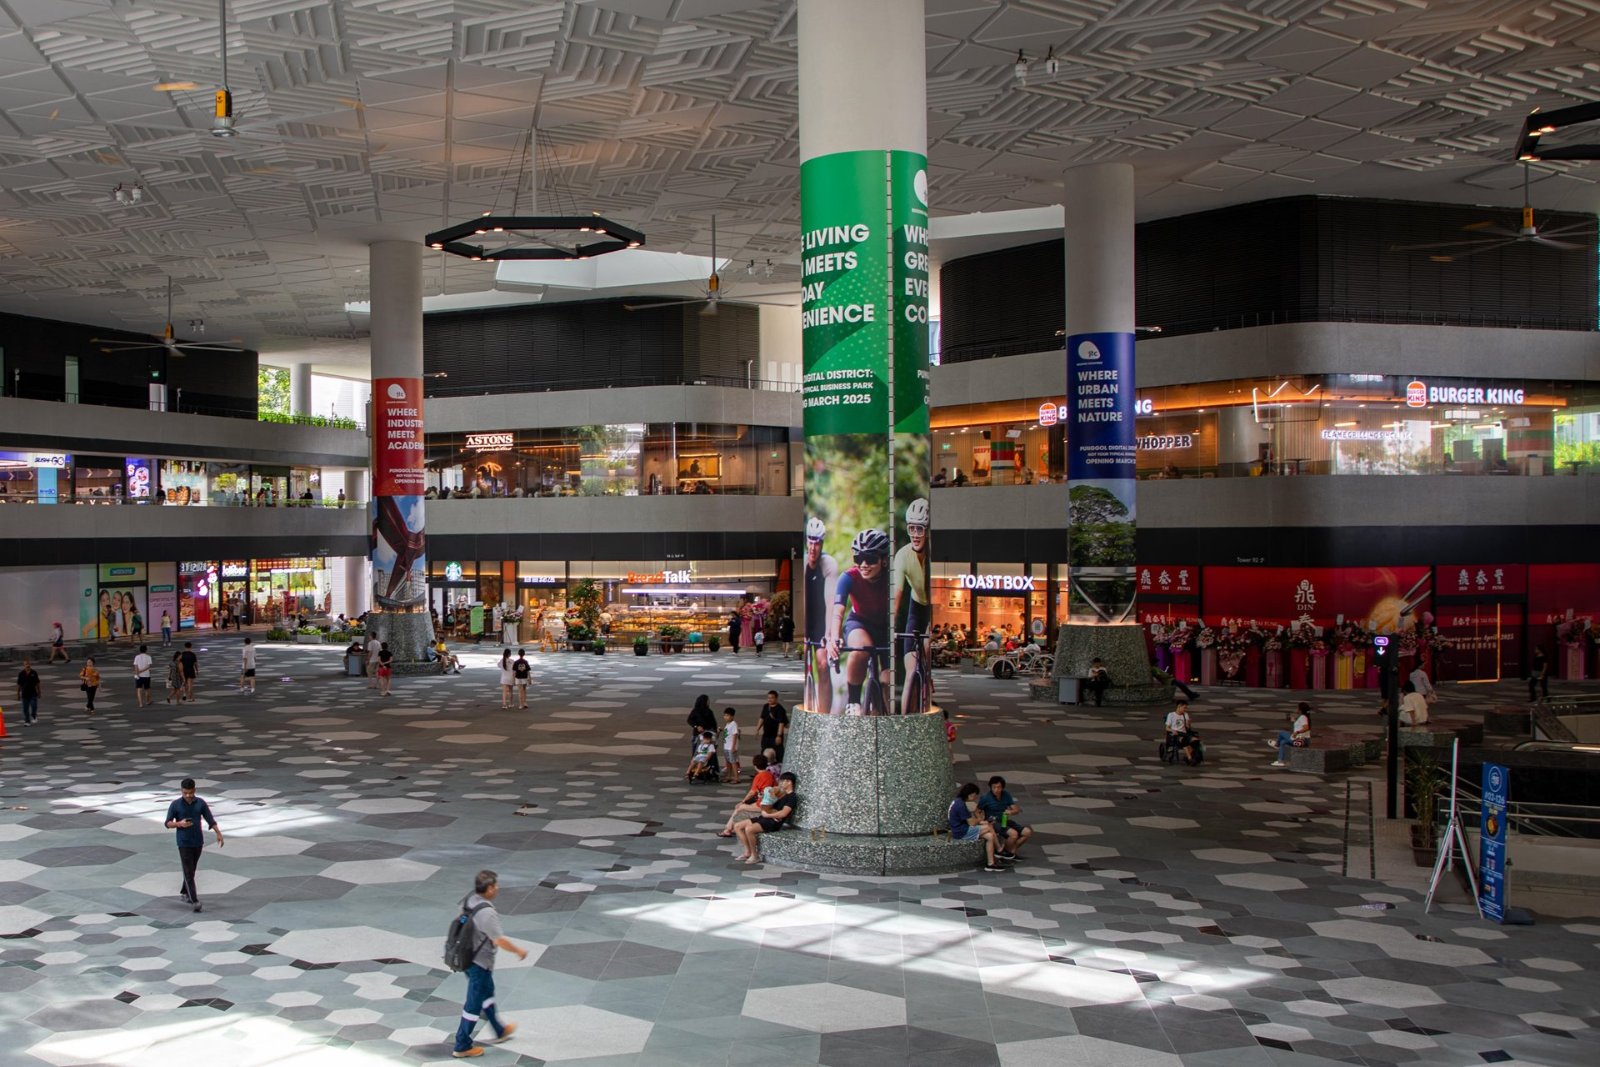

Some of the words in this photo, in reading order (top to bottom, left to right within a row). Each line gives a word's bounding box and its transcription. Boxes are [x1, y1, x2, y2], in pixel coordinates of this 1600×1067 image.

[806, 224, 869, 250] LIVING
[806, 251, 857, 276] MEETS
[827, 369, 873, 379] DISTRICT:
[1078, 370, 1118, 381] WHERE
[821, 383, 851, 391] BUSINESS
[1078, 384, 1118, 395] URBAN
[808, 396, 840, 407] MARCH
[843, 394, 871, 404] 2025
[1430, 387, 1484, 404] BURGER
[1486, 389, 1524, 404] KING
[1078, 398, 1114, 409] MEETS
[387, 408, 418, 417] WHERE
[1078, 412, 1122, 423] NATURE
[387, 430, 415, 439] MEETS
[466, 435, 513, 445] ASTONS
[958, 574, 1002, 589] TOAST
[1003, 575, 1035, 591] BOX
